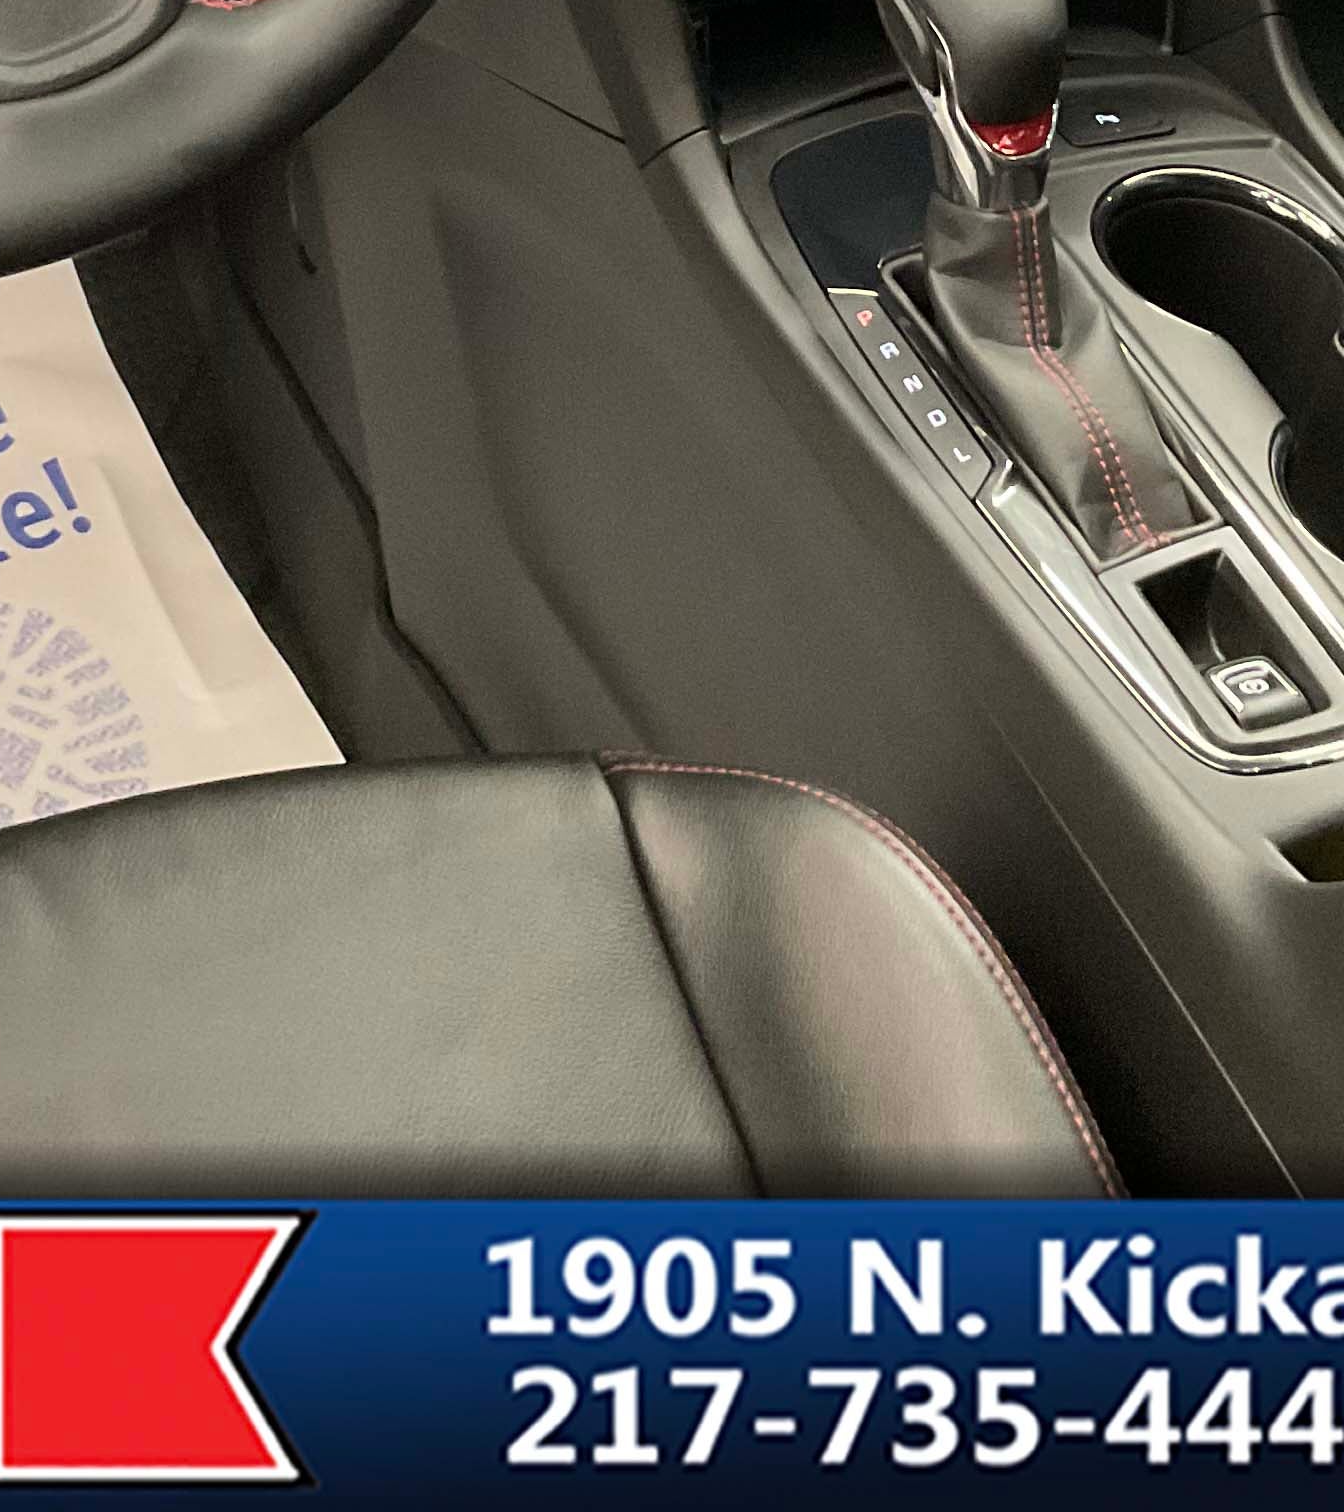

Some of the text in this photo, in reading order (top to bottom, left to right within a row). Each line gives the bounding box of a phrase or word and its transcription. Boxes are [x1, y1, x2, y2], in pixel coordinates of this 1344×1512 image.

[856, 310, 873, 327] P
[879, 342, 901, 360] R
[902, 374, 924, 394] N
[926, 408, 948, 428] D
[953, 447, 972, 463] L
